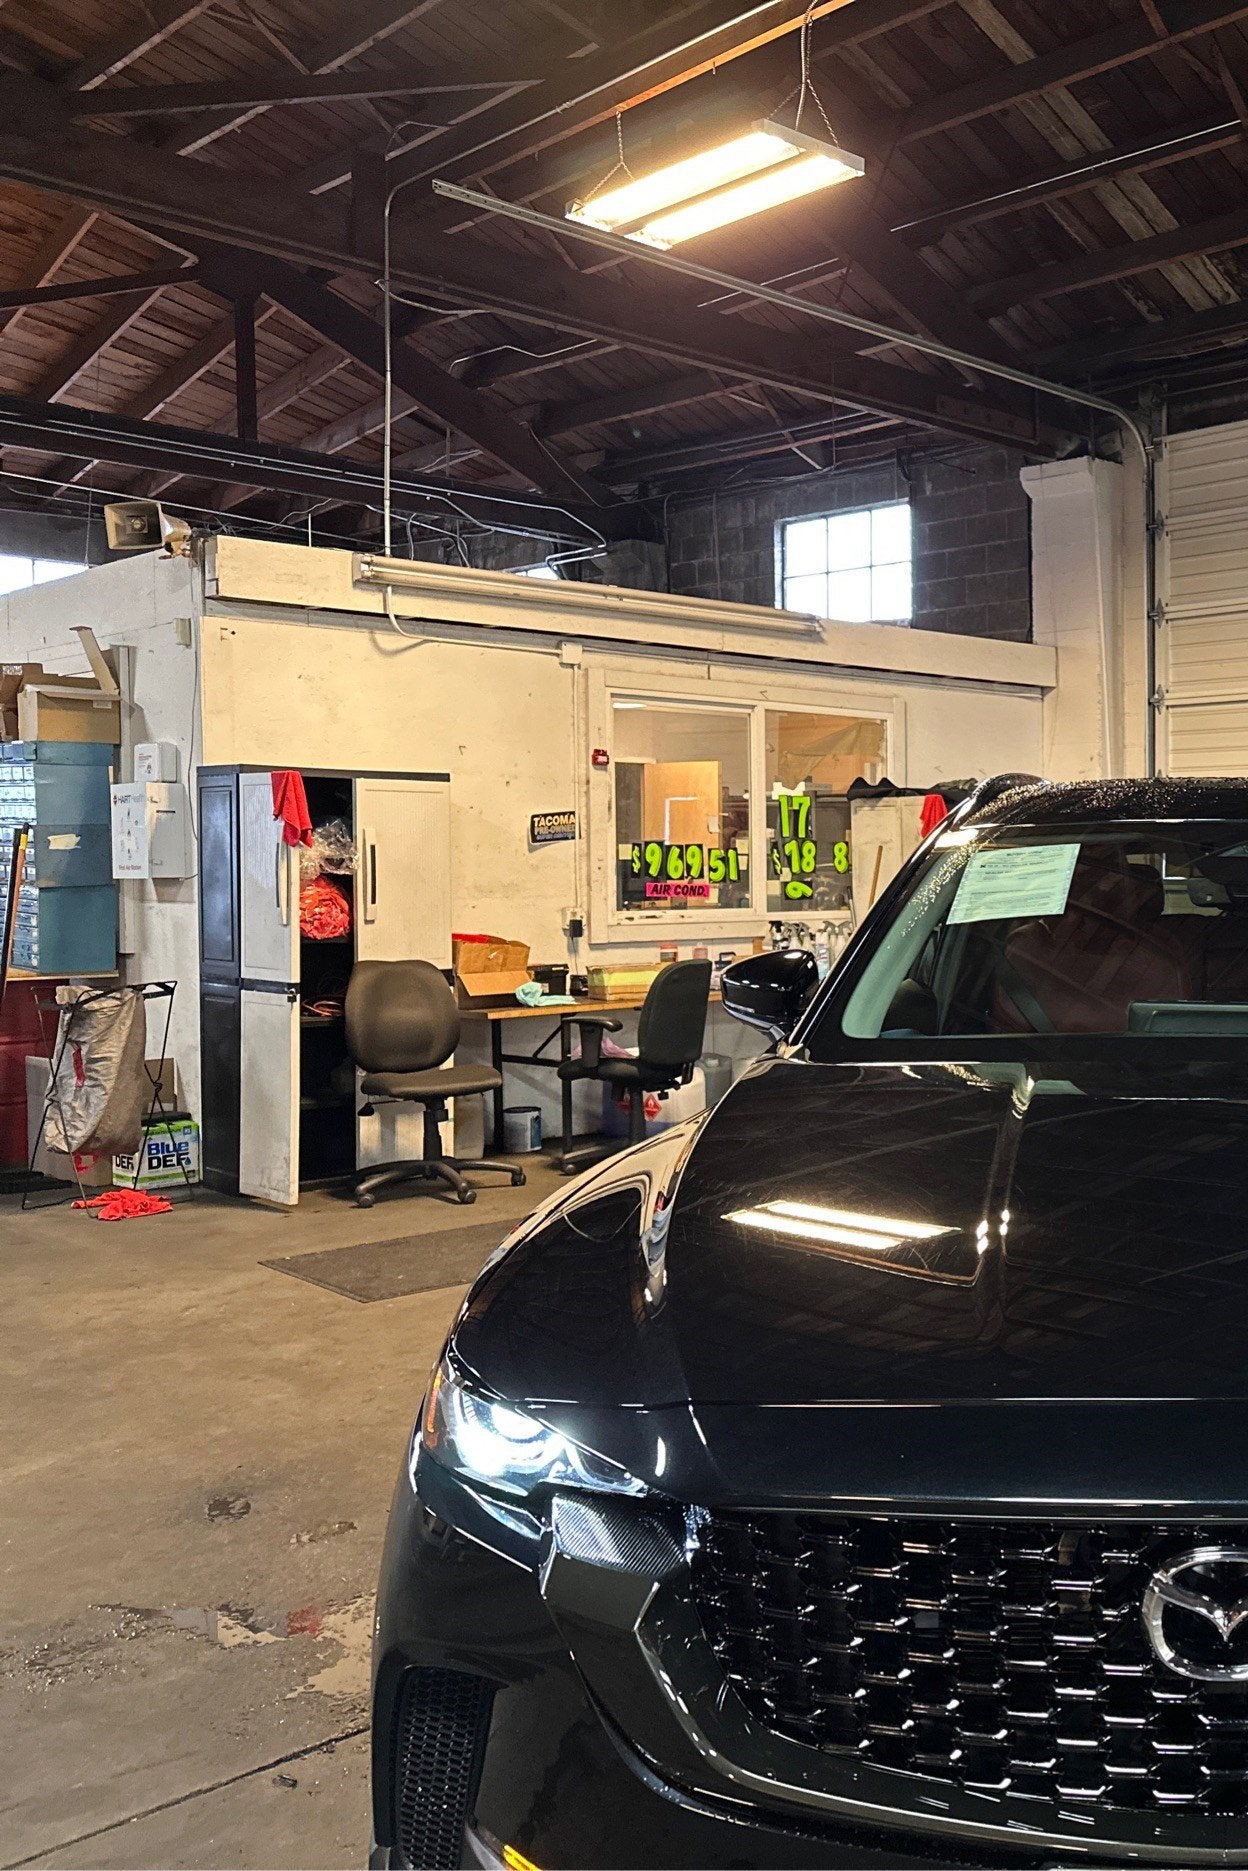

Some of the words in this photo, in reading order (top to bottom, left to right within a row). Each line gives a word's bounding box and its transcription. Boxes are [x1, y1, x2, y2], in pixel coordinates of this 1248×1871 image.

[533, 814, 576, 827] TACOMA
[779, 794, 811, 838] 17
[651, 884, 671, 896] AIR
[674, 884, 706, 897] COND.
[147, 1142, 189, 1156] Blue
[148, 1152, 189, 1171] DEF
